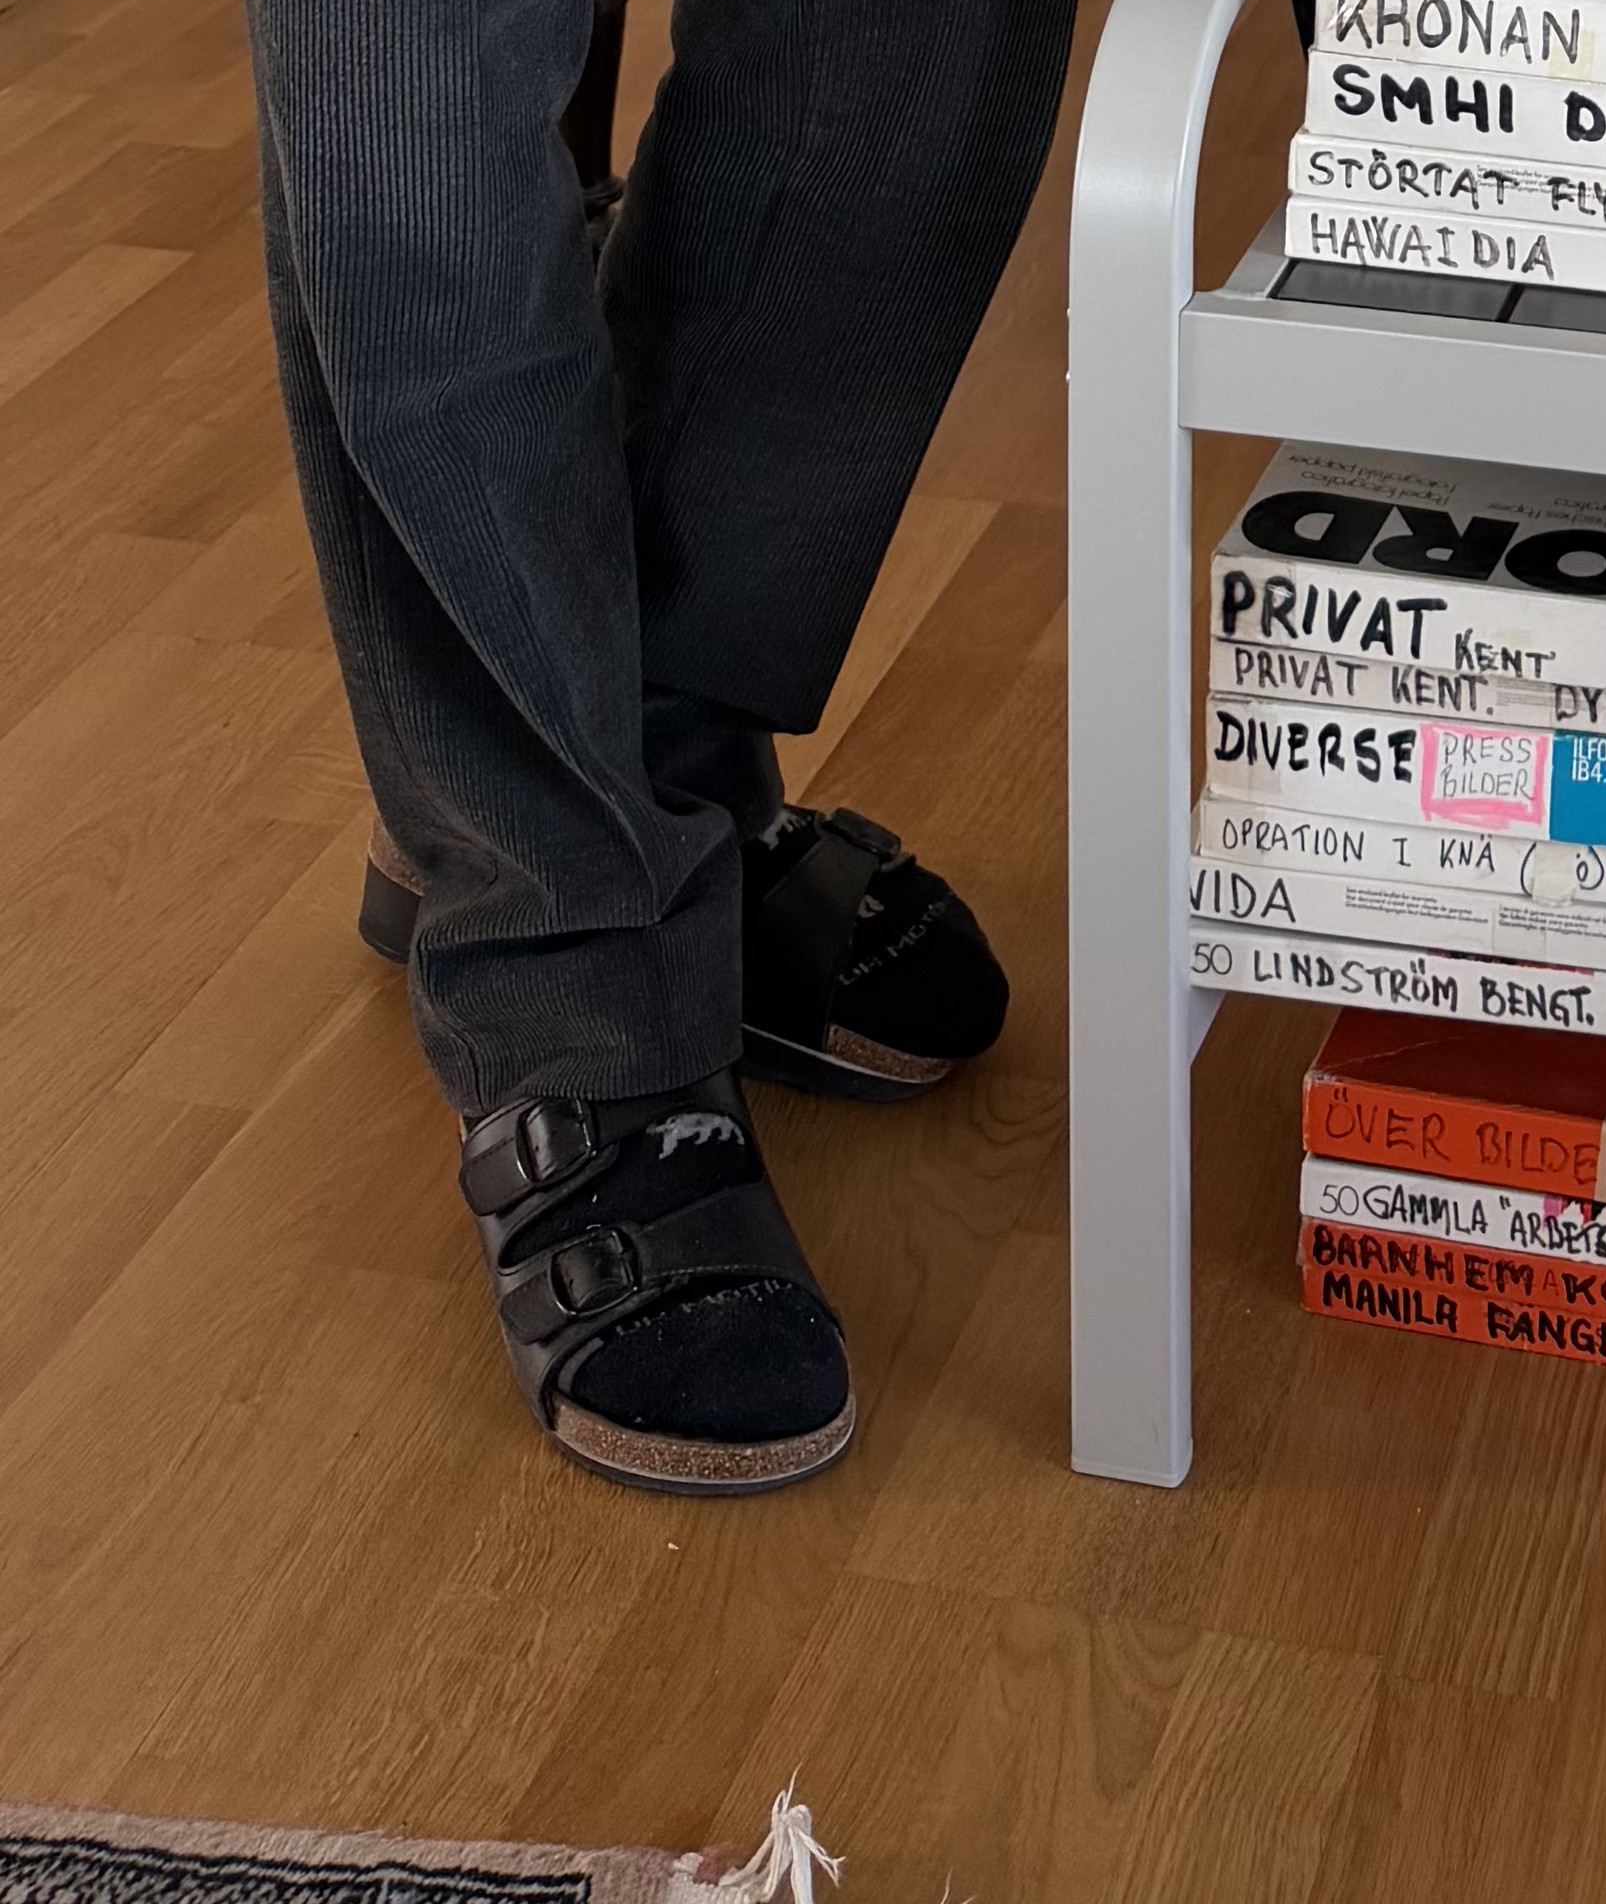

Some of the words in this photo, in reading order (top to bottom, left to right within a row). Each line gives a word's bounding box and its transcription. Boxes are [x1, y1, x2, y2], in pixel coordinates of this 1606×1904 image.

[1332, 62, 1515, 135] SMHI
[1307, 148, 1520, 211] STÖRTAT
[1309, 212, 1460, 269] HAWAI
[1472, 228, 1556, 282] DIA
[1221, 569, 1449, 660] PRIVAT
[1454, 628, 1557, 680] KENT
[1234, 646, 1370, 698] PRIVAT
[1213, 710, 1418, 784] DIVERSE
[1442, 731, 1534, 765] PRESS
[1440, 763, 1536, 801] BILDER
[1221, 817, 1365, 863] OPRATION
[1439, 834, 1497, 874] KNÄ
[1191, 944, 1233, 975] 50
[1253, 950, 1458, 1013] LINDSTRÖM
[1324, 1086, 1451, 1162] ÖVER
[1318, 1183, 1360, 1216] 50
[1362, 1183, 1489, 1237] GAMMLA
[1311, 1223, 1534, 1296] BARNHEM
[1321, 1269, 1458, 1334] MANILA
